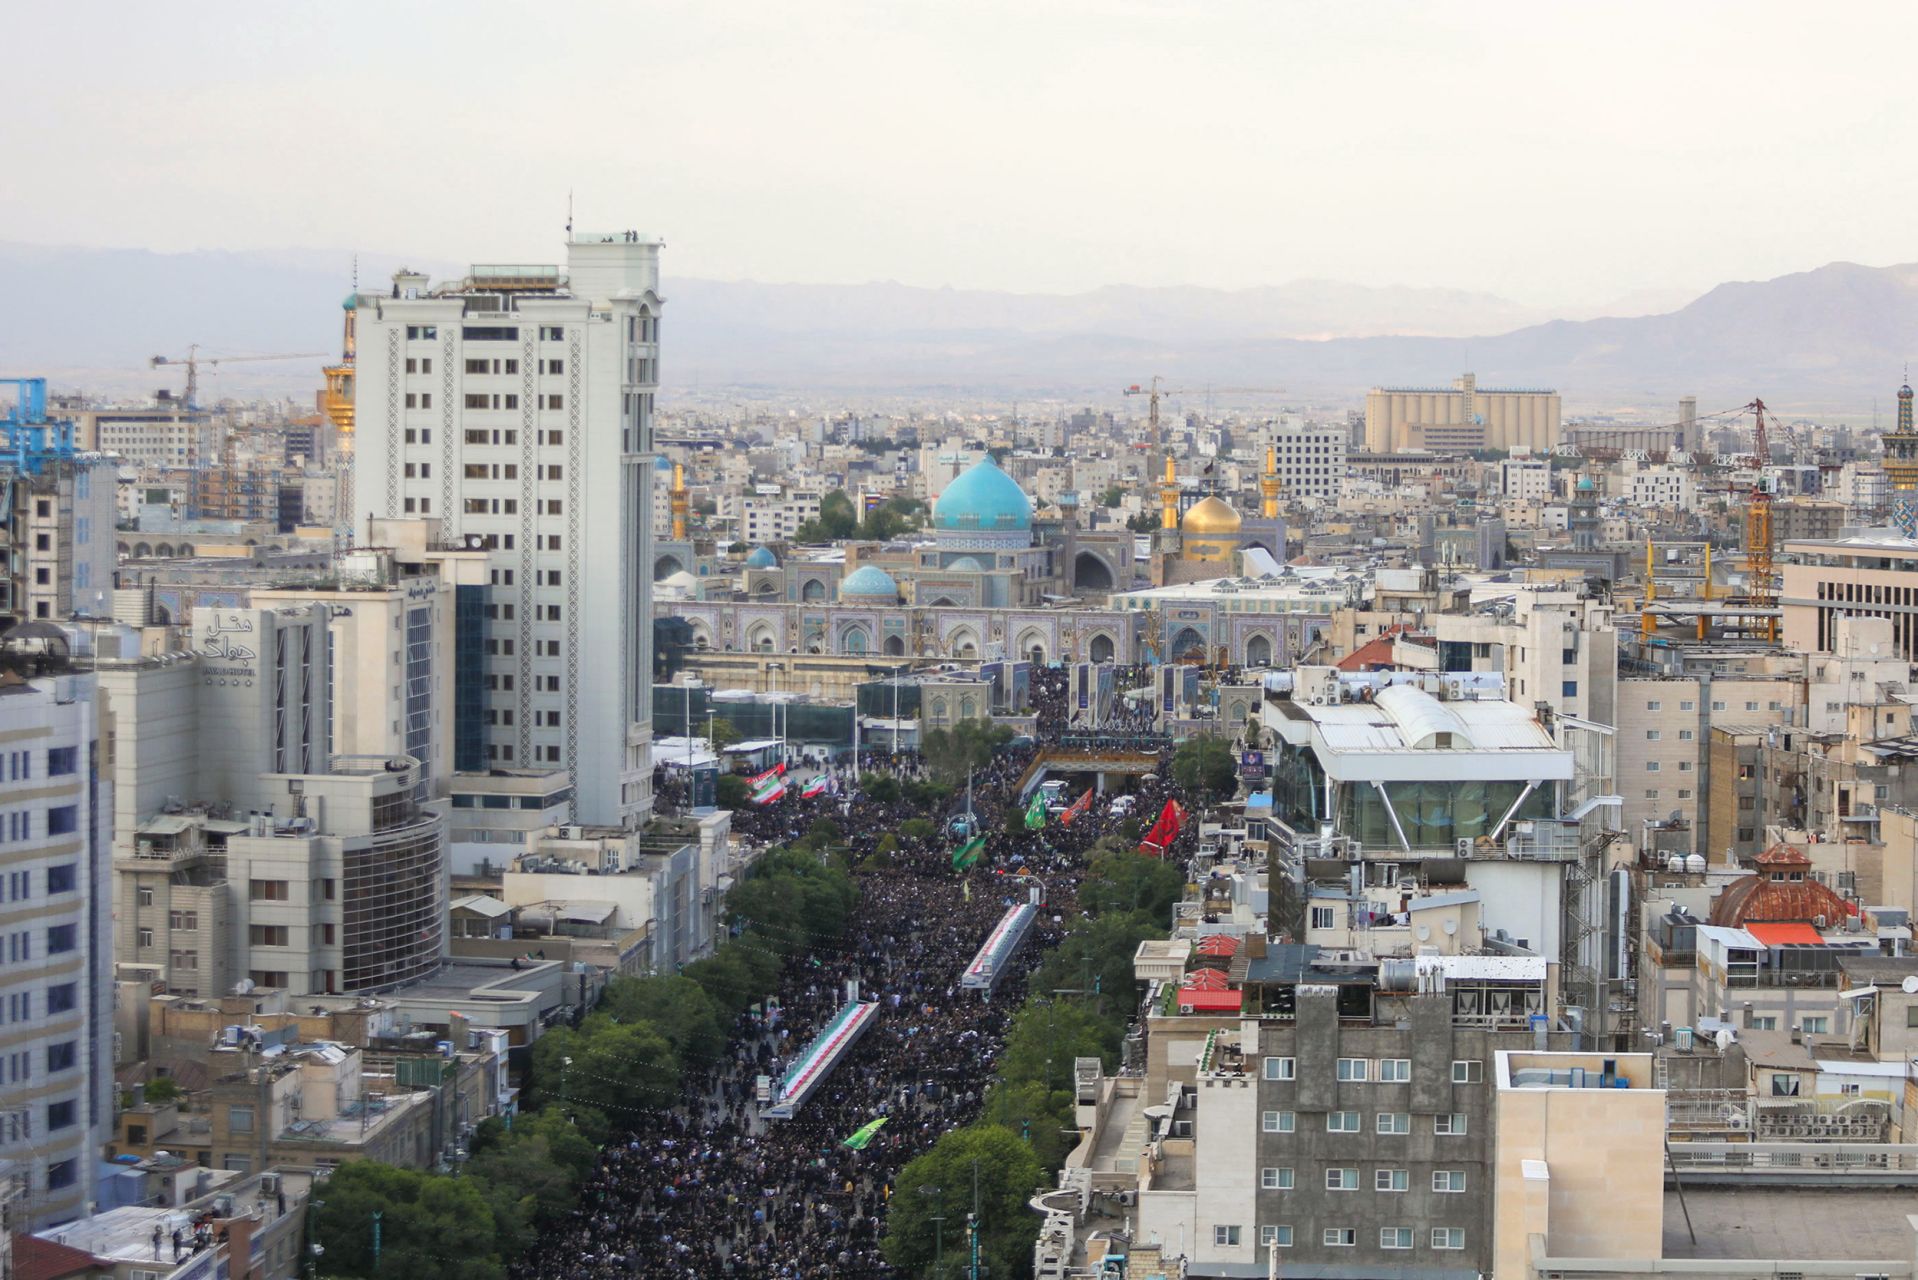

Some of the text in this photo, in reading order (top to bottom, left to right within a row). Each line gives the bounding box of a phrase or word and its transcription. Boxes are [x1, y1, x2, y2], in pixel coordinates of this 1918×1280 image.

[329, 605, 353, 622] هتل
[207, 614, 253, 637] هتل
[205, 636, 256, 667] جواد
[229, 667, 256, 677] HOTEL
